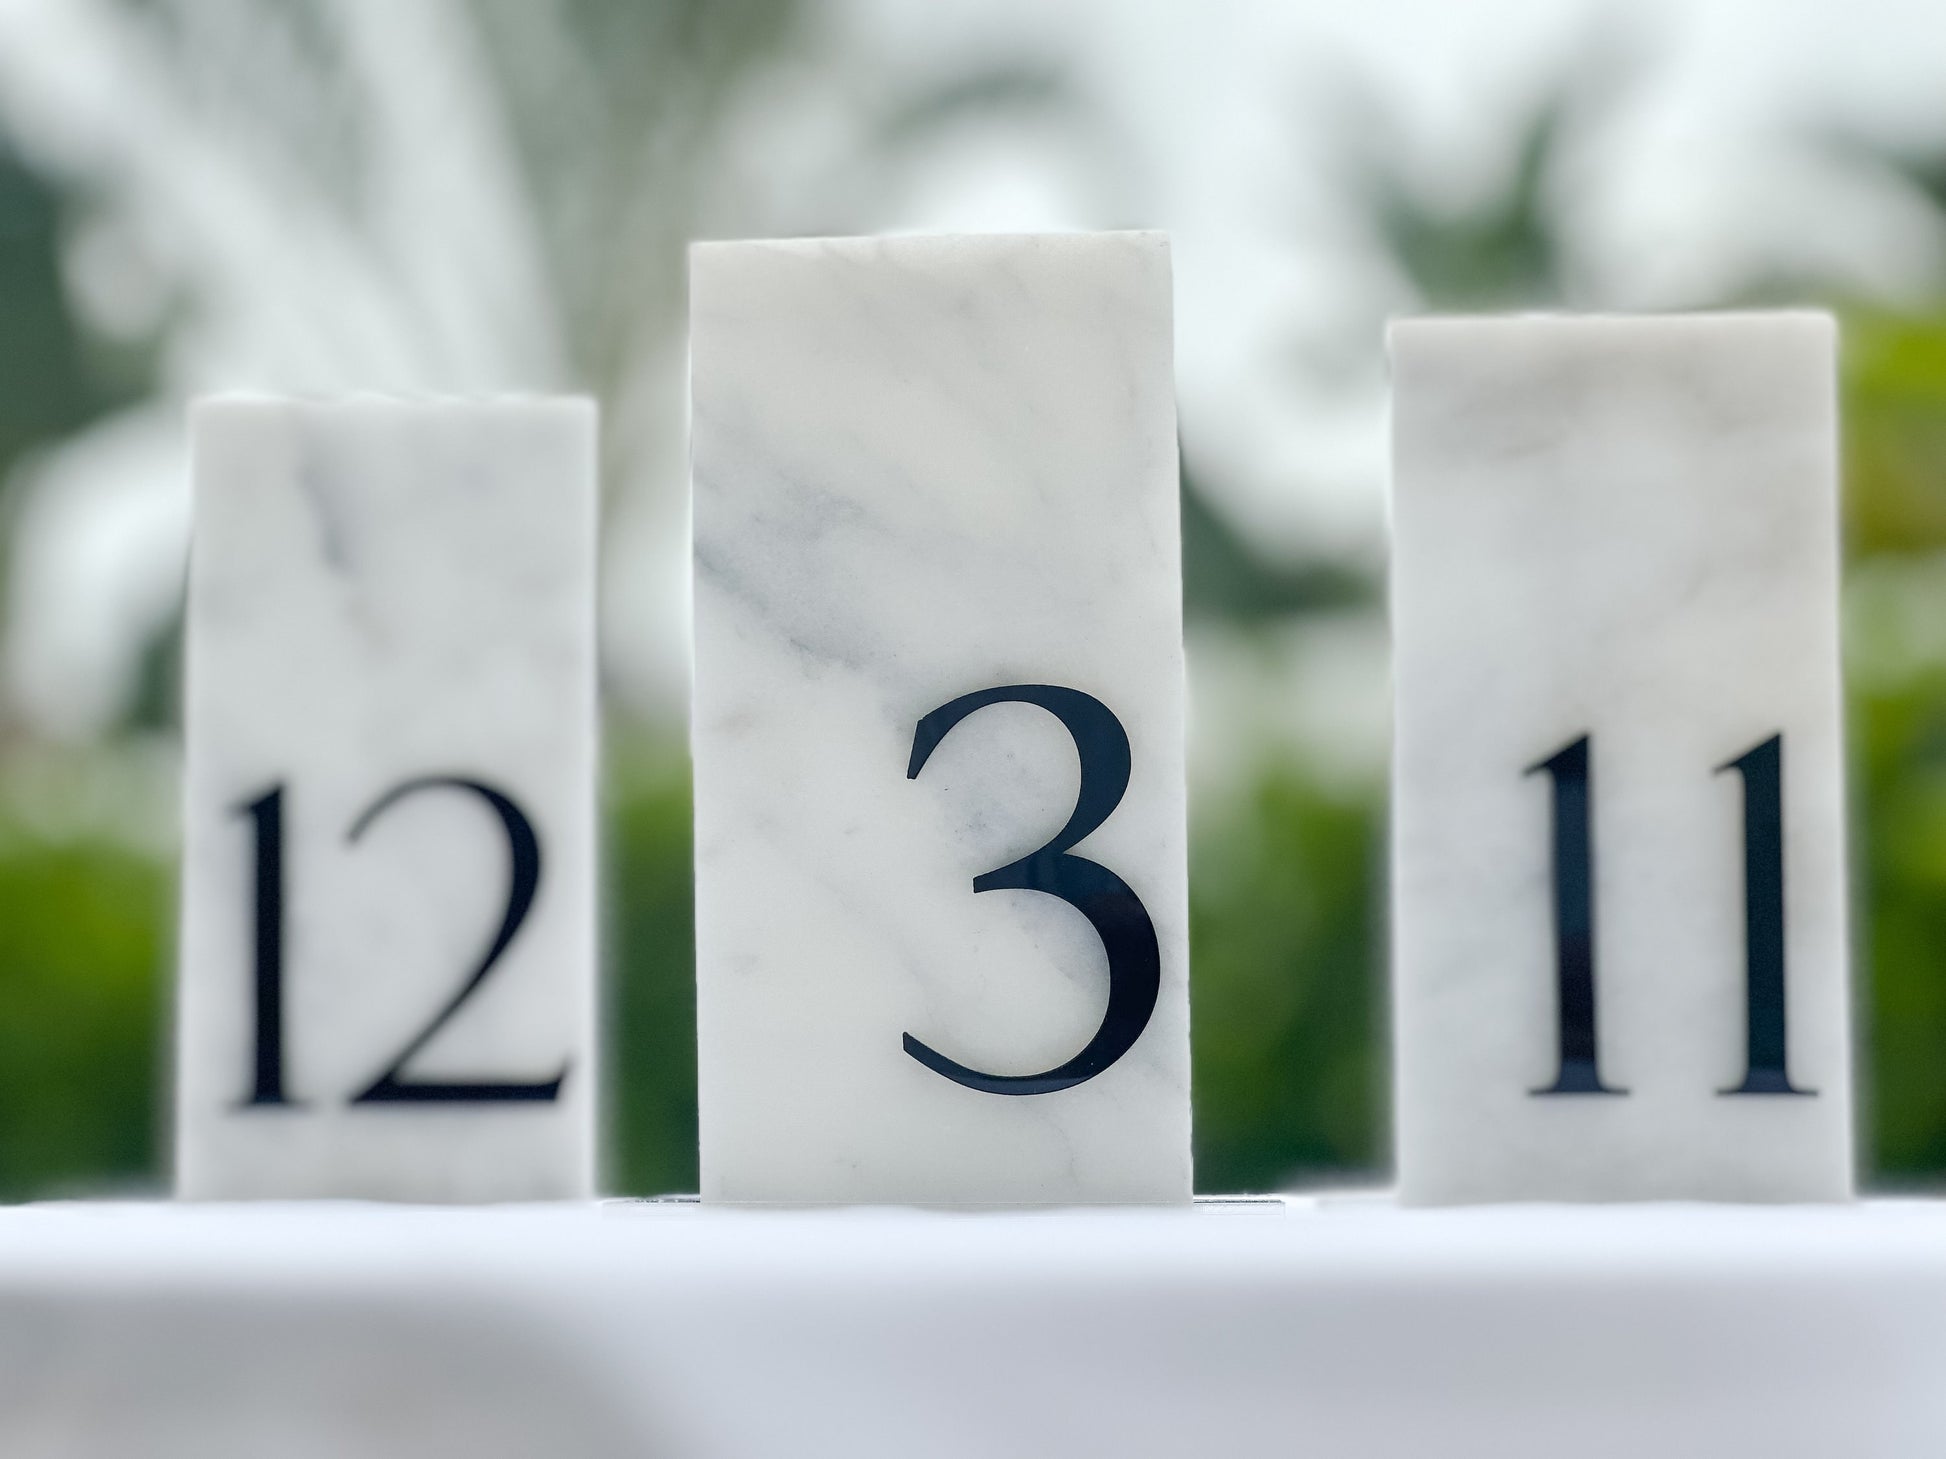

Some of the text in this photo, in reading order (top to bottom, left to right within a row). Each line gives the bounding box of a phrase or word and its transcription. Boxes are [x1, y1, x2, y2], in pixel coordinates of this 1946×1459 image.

[230, 774, 571, 1112] 12
[902, 683, 1162, 1097] 3
[1523, 731, 1819, 1099] 11
